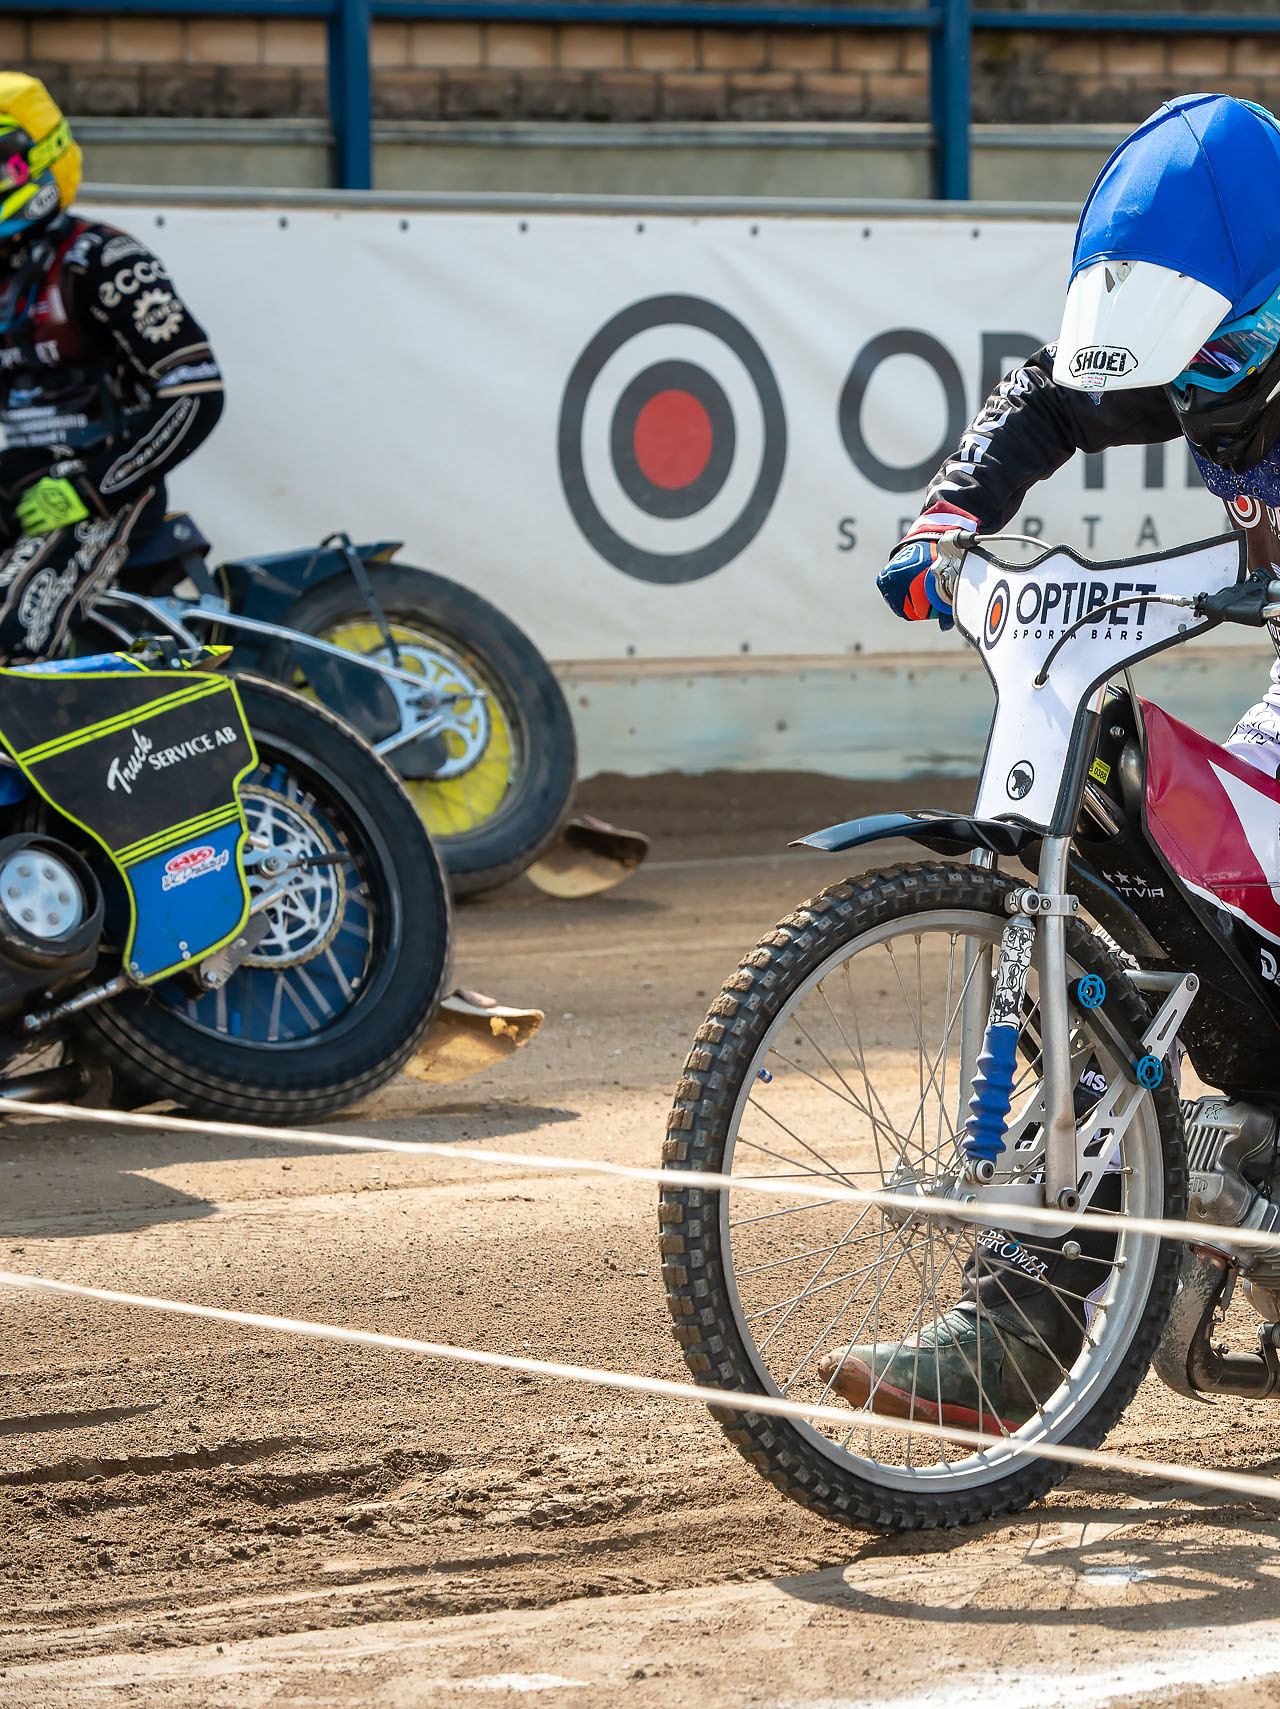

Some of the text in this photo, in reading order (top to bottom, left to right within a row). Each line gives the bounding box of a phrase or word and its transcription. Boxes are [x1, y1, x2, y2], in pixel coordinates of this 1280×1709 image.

[1074, 350, 1127, 372] SHOEI
[1016, 582, 1157, 626] OPTIBET
[1013, 626, 1144, 641] SPORTA BĀRS
[107, 726, 237, 794] Truck SERVICE AB
